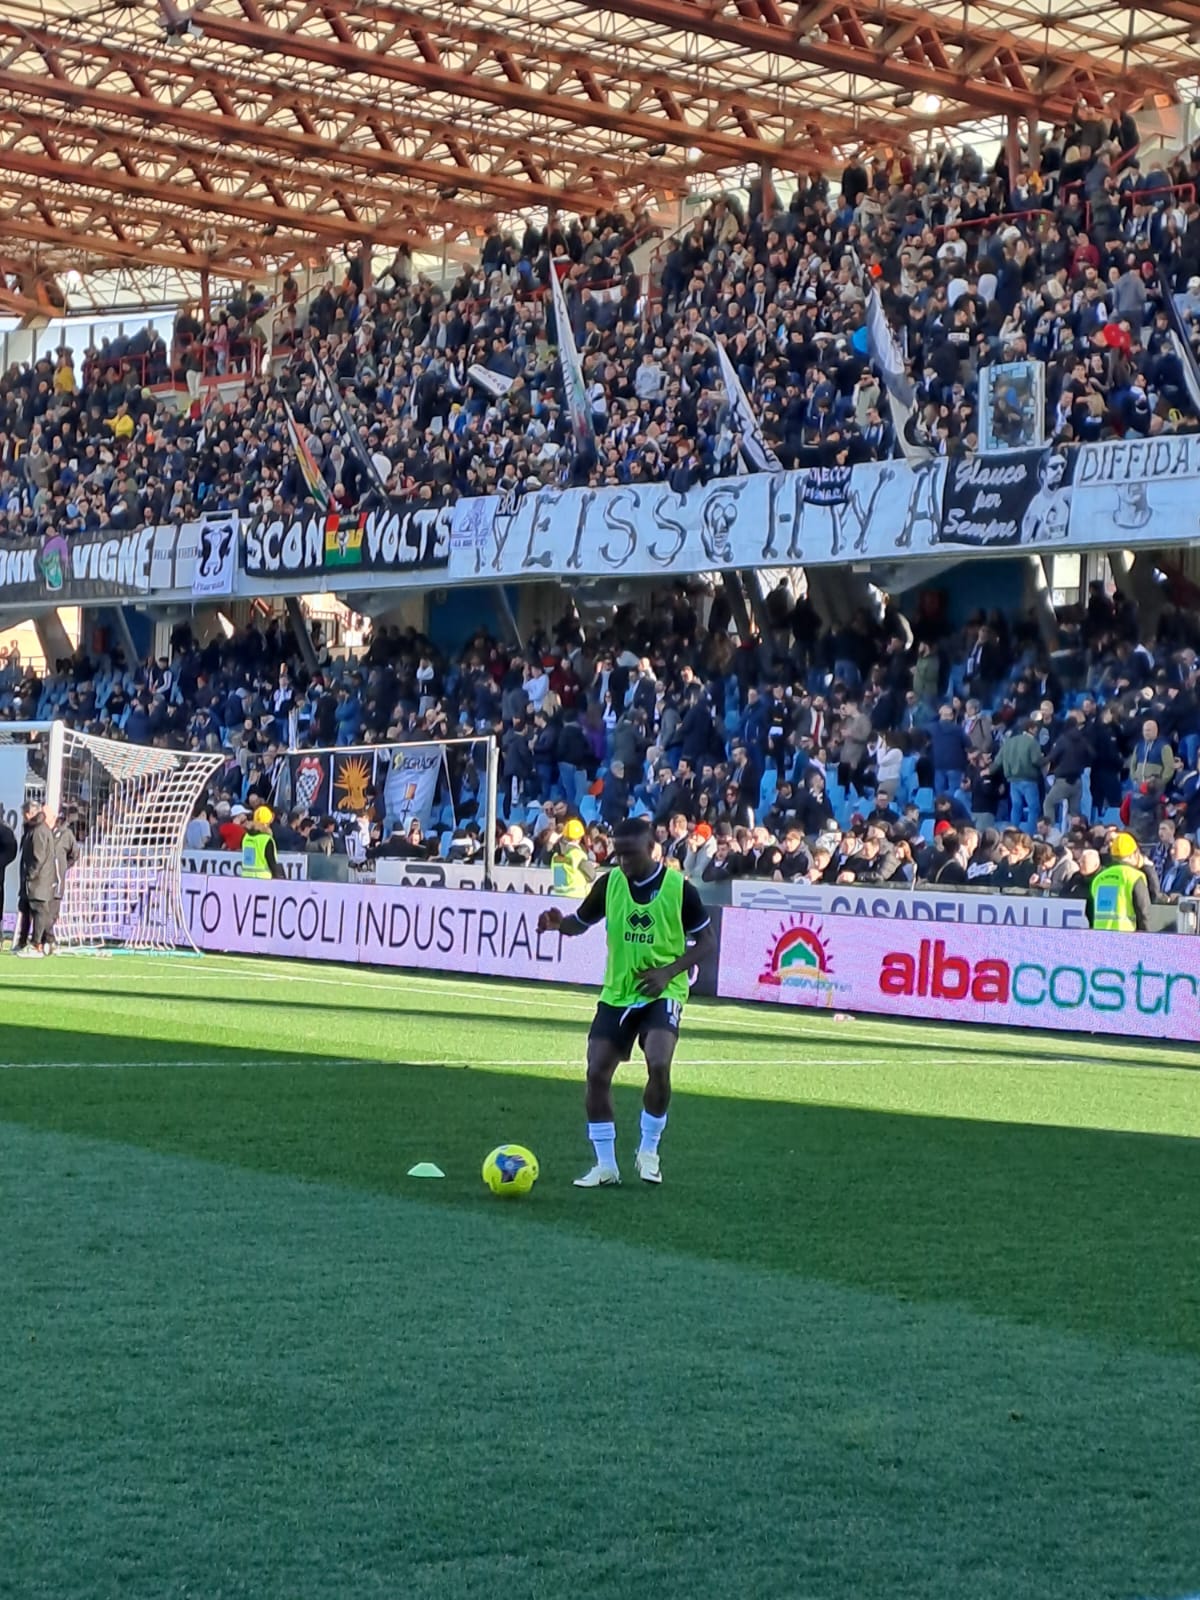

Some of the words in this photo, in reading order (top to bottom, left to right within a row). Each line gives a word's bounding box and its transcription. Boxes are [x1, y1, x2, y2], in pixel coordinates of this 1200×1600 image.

[954, 458, 1027, 492] Glauco
[1080, 438, 1200, 481] DIFFIDA
[943, 508, 1018, 545] Sempre
[72, 526, 155, 594] VIGNE
[233, 892, 346, 943] VEICOLI
